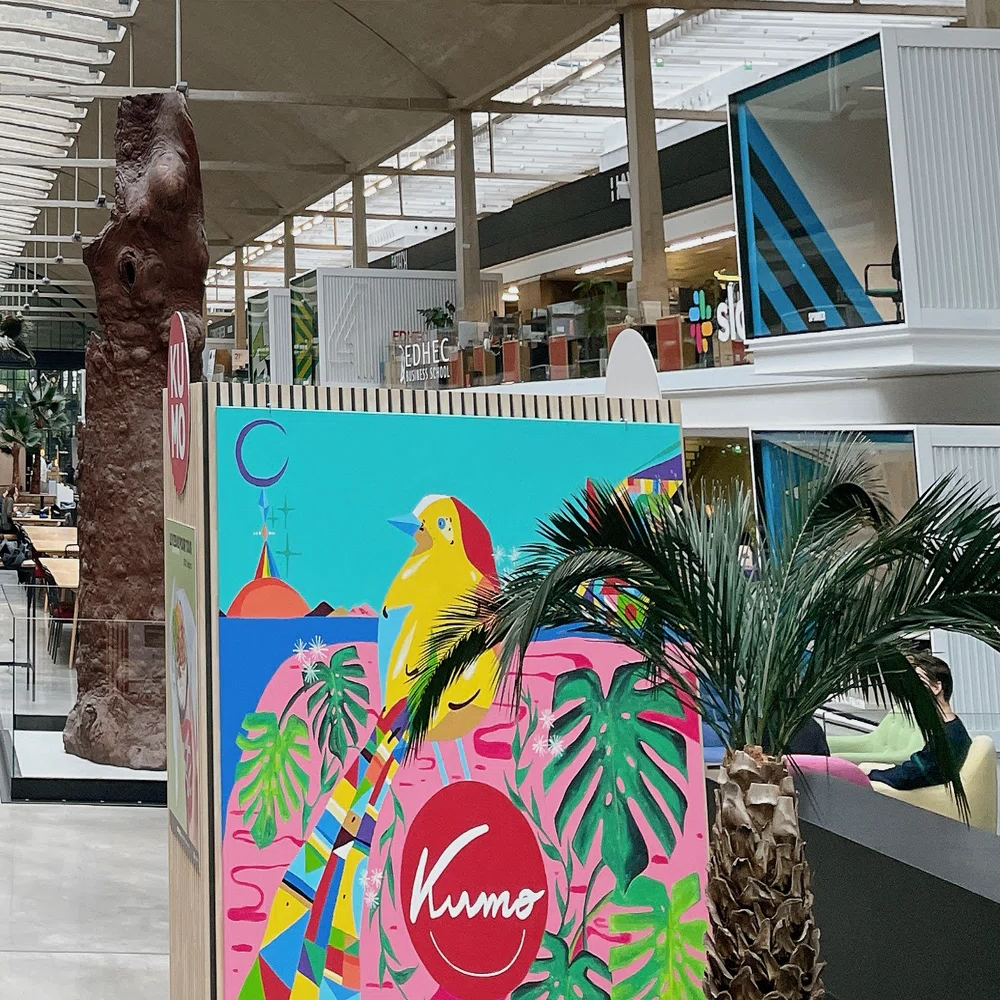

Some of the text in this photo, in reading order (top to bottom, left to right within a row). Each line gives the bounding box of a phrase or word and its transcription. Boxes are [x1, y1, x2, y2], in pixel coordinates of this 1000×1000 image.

[170, 341, 185, 398] KU
[405, 337, 449, 367] EDHEC
[429, 365, 450, 380] SCHOOL
[171, 403, 186, 461] MO
[410, 824, 545, 924] Kumo
